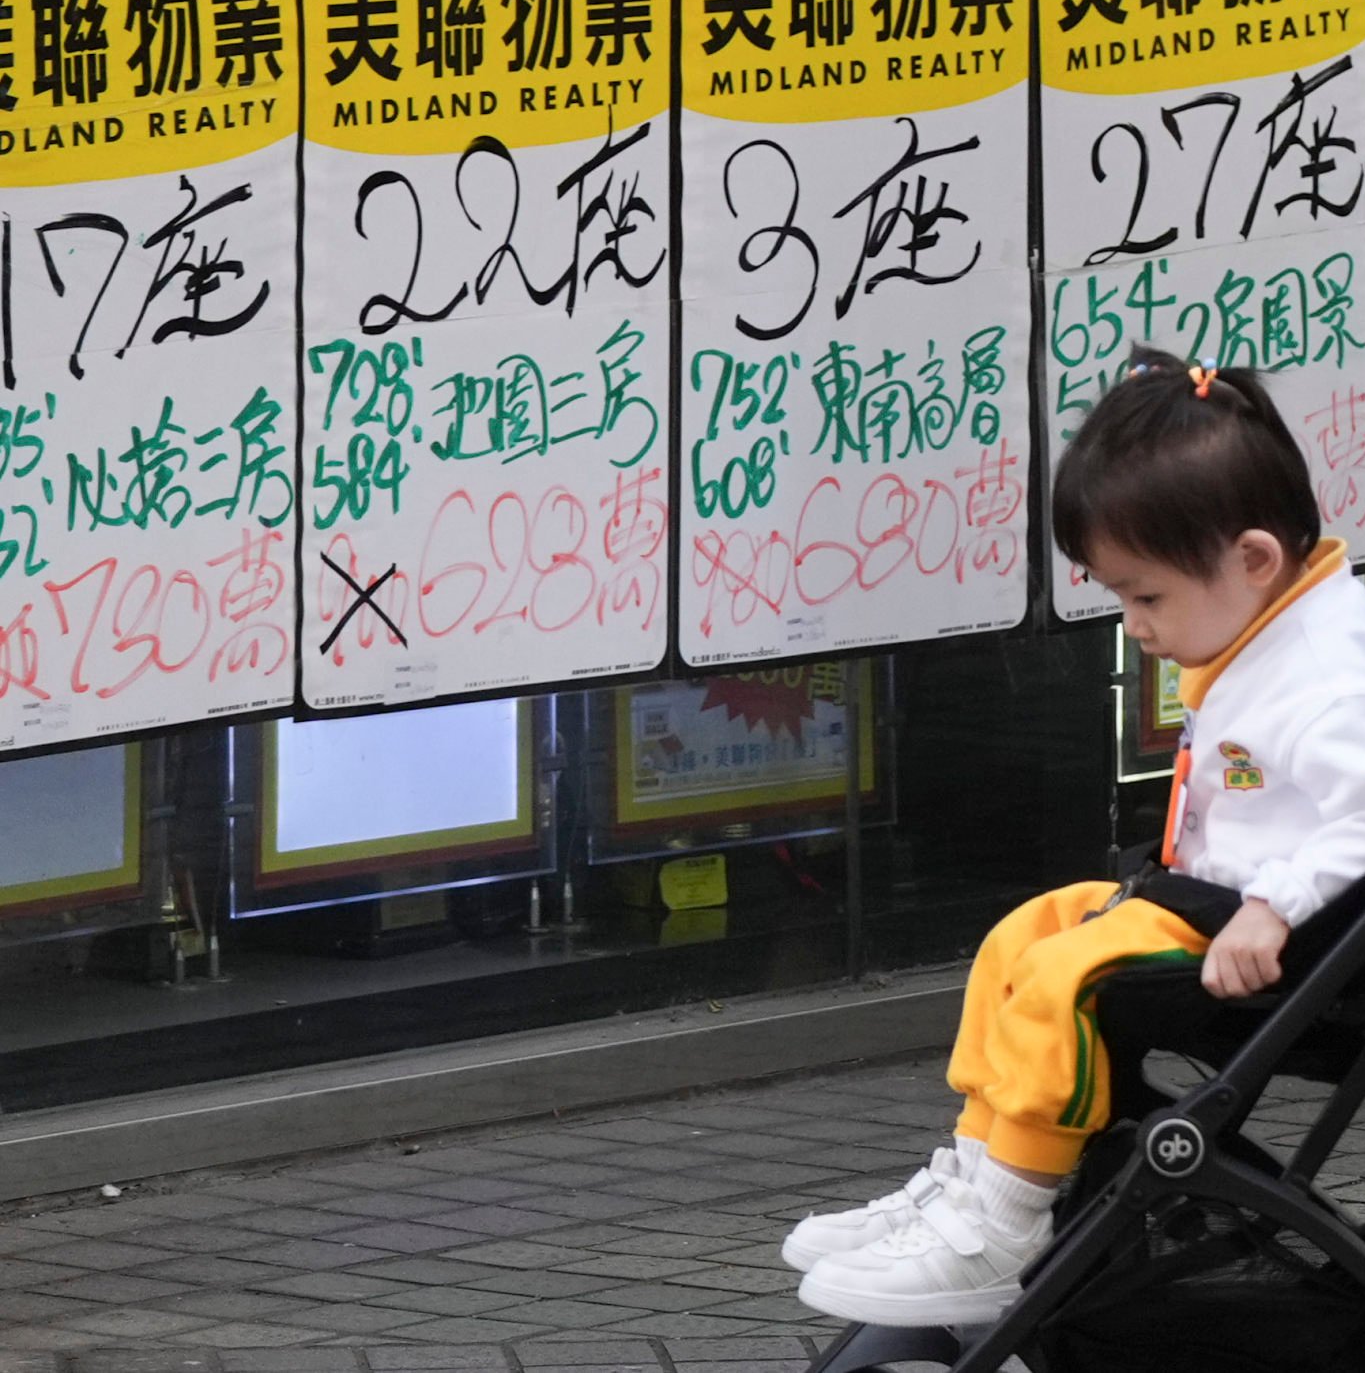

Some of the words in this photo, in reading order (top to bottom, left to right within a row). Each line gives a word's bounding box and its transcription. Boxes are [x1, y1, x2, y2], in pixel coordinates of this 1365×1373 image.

[1066, 28, 1216, 72] MIDLAND
[1236, 6, 1353, 48] REALTY
[709, 60, 868, 97] MIDLAND
[886, 47, 1006, 82] REALTY
[149, 98, 278, 138] REALTY
[333, 91, 498, 128] MIDLAND
[519, 78, 644, 113] REALTY
[1083, 54, 1365, 268] 27座
[355, 106, 667, 336] 22座
[722, 114, 982, 342] 3座
[1158, 1132, 1193, 1164] gb
